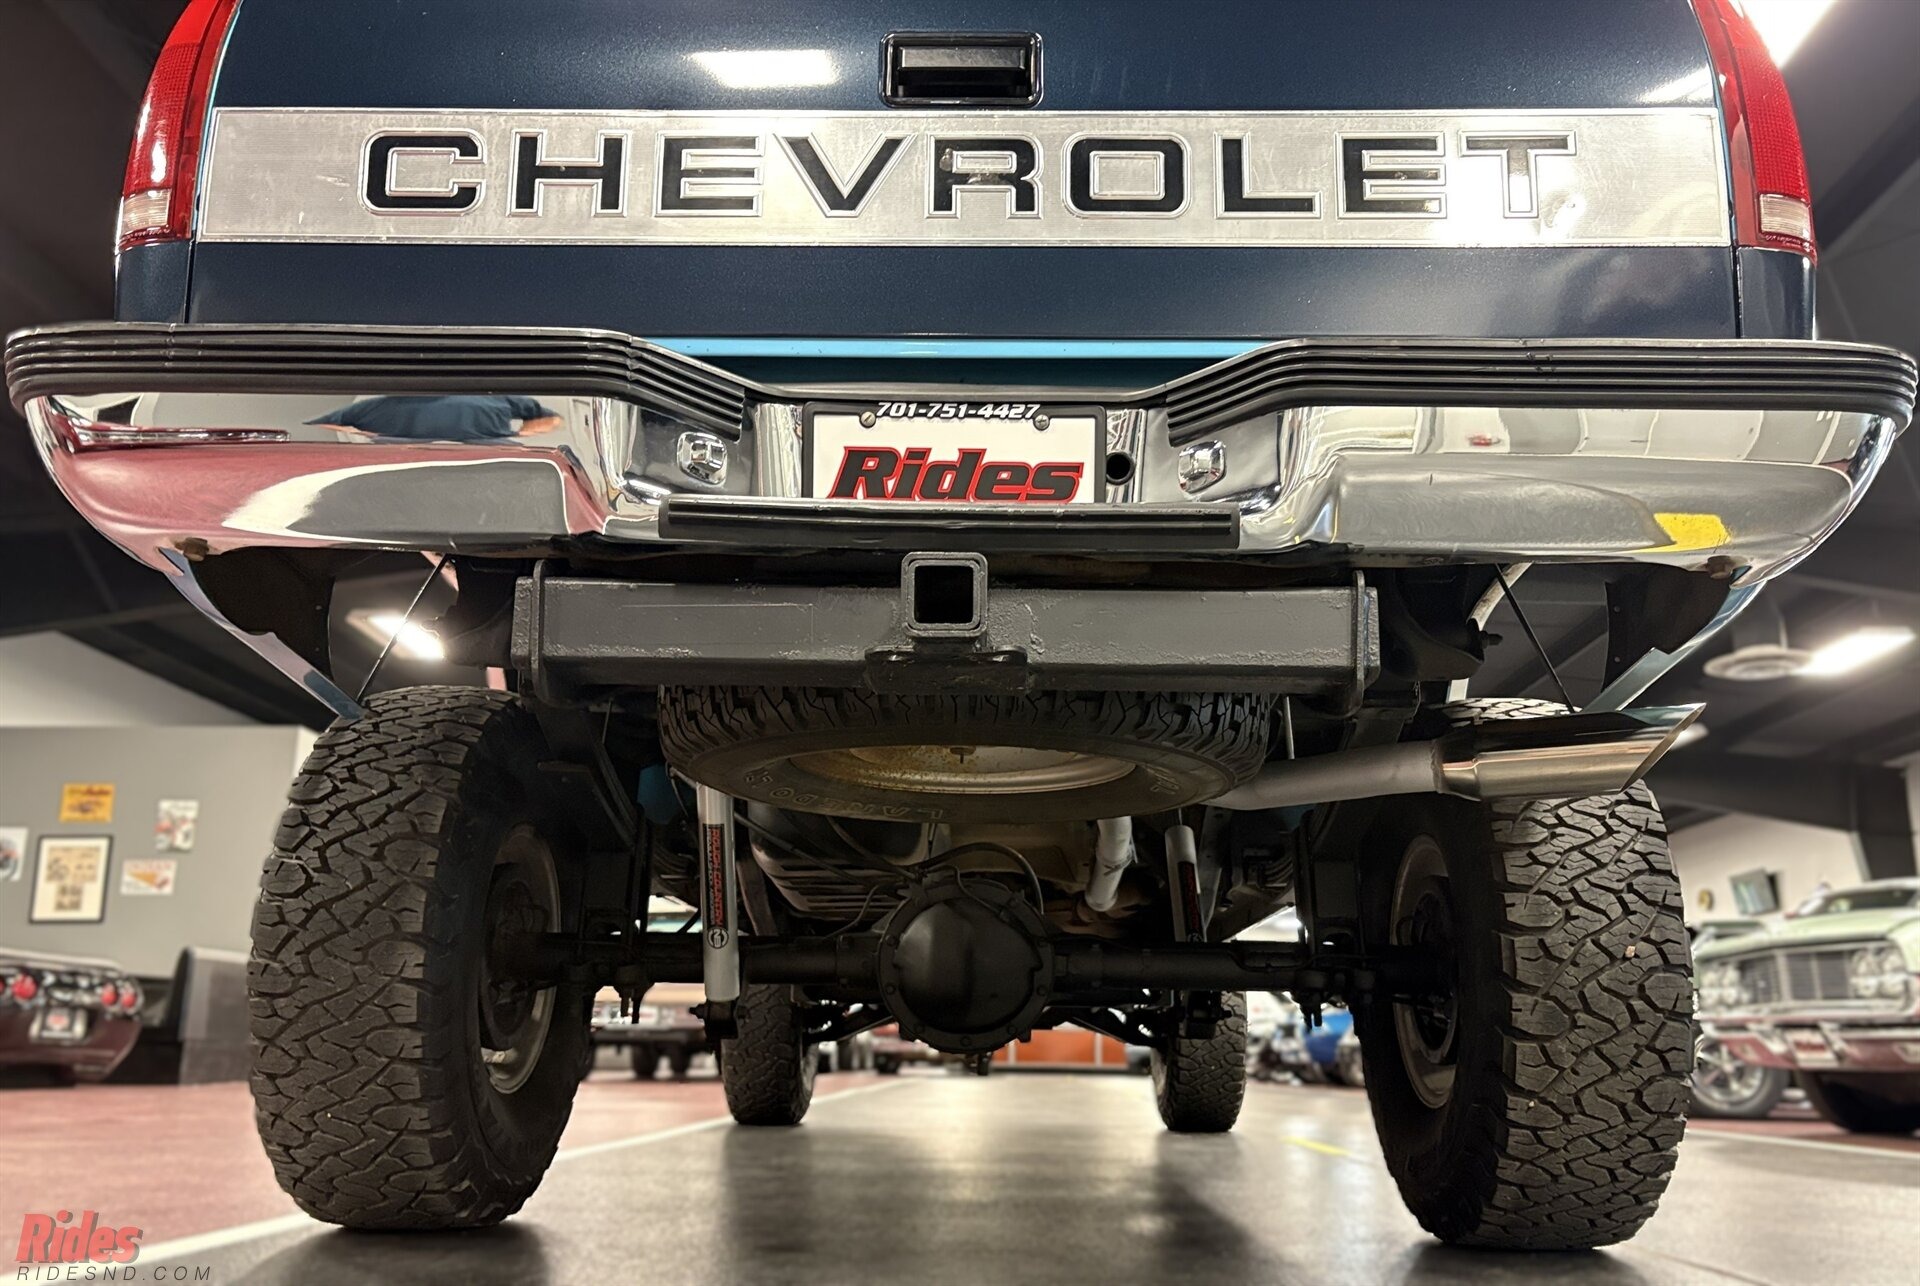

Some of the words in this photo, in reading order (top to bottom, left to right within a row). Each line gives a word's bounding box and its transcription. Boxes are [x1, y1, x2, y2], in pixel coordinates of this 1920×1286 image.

[357, 128, 1577, 220] CHEVROLET
[876, 402, 1041, 420] 701-751-4427
[826, 446, 1085, 504] Rides
[711, 828, 721, 868] ROUGH
[713, 871, 724, 926] COUNTRY
